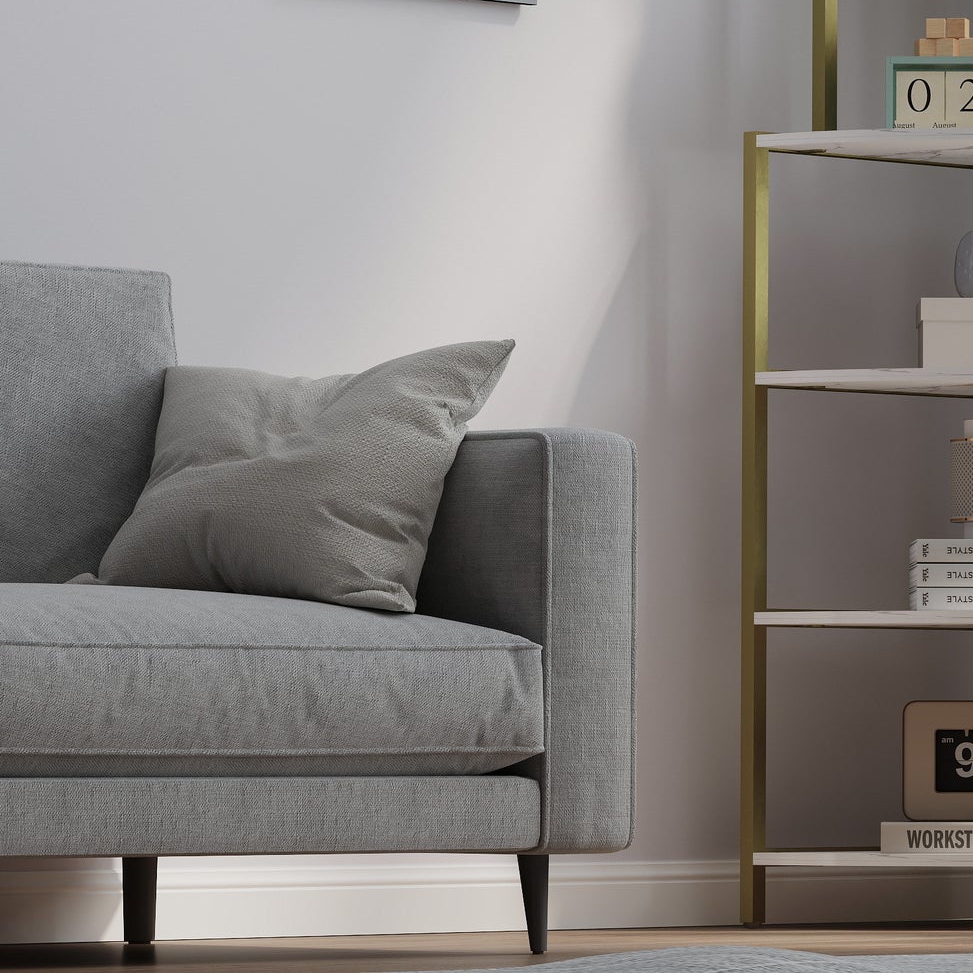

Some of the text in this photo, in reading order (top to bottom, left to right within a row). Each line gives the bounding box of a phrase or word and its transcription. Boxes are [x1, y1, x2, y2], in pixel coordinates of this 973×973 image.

[947, 546, 973, 555] STYLE
[947, 571, 973, 580] STYLE
[947, 595, 973, 604] STYLE
